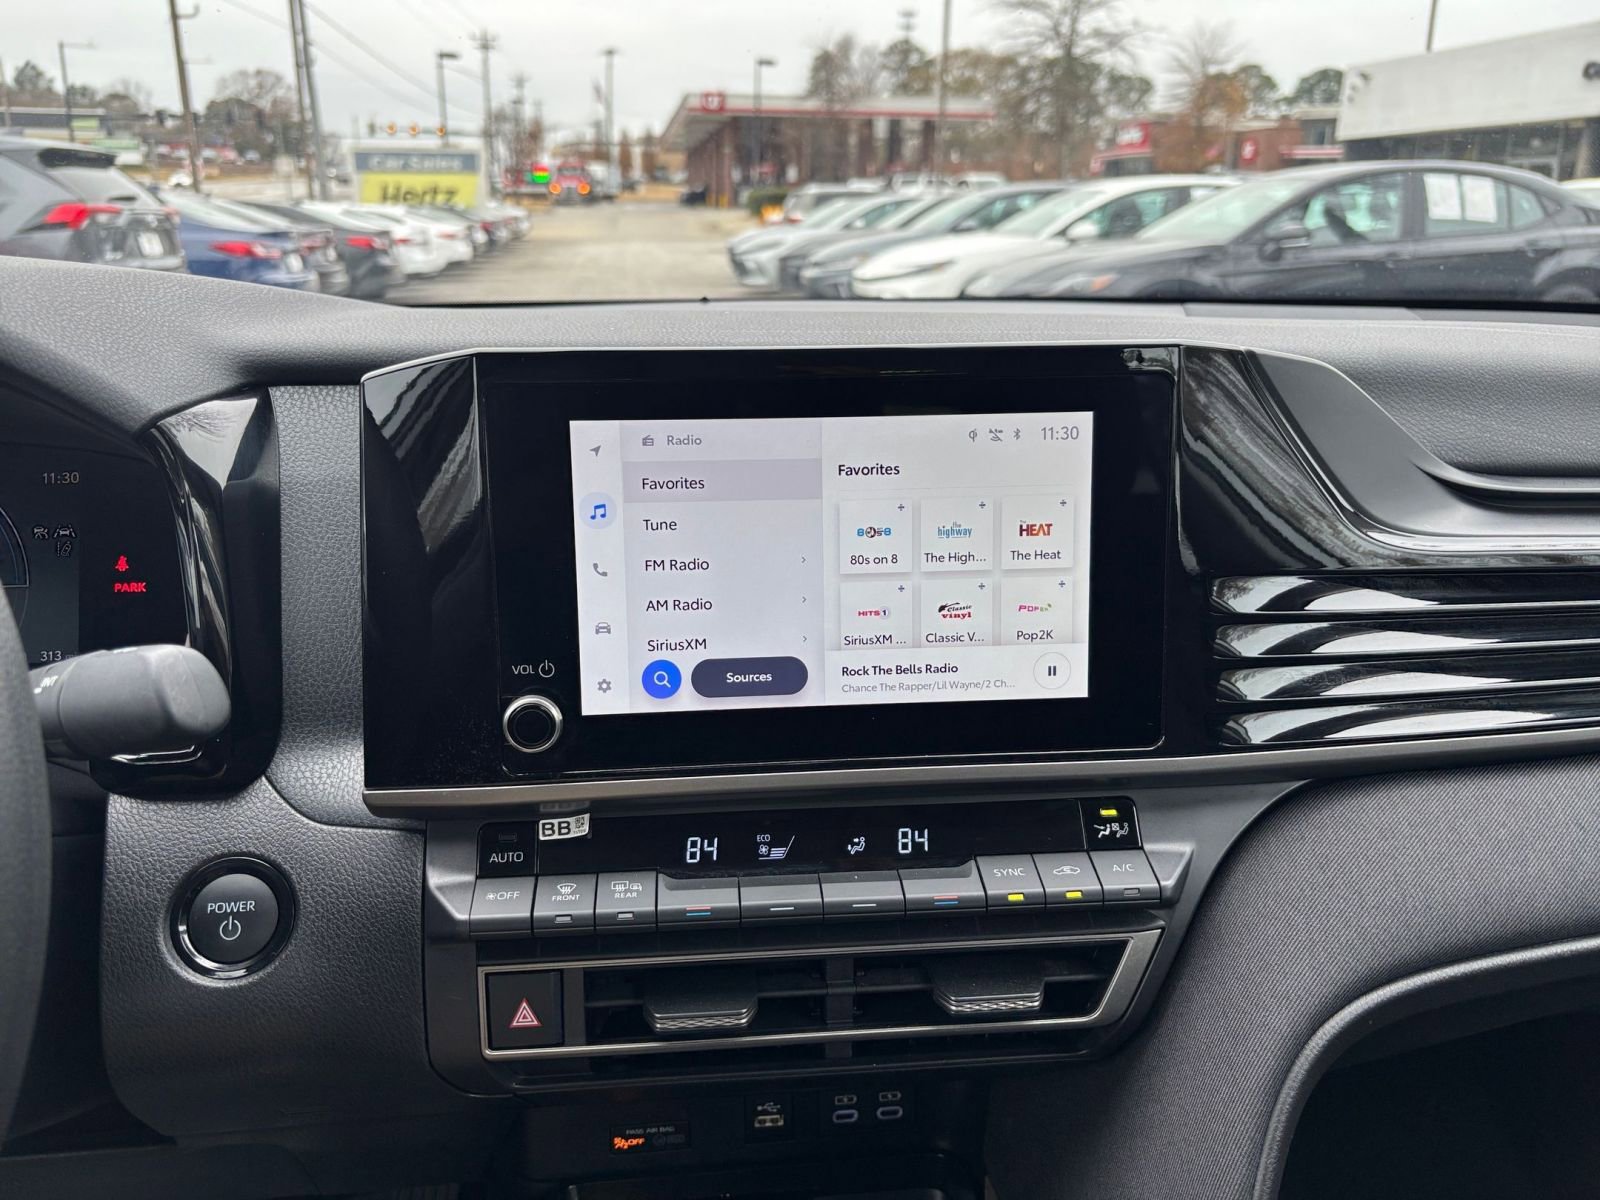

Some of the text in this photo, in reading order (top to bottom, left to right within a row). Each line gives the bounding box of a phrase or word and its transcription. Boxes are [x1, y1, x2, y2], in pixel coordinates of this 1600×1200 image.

[381, 182, 459, 205] Hertz
[1040, 425, 1080, 441] 11:30
[666, 434, 703, 446] Radio
[838, 463, 900, 477] Favorites
[42, 472, 80, 485] 11:30
[641, 476, 705, 490] Favorites
[643, 518, 678, 531] Tune
[1019, 523, 1053, 537] HEAT
[937, 525, 973, 539] highway
[850, 554, 898, 565] 80s on 8
[924, 552, 946, 563] The
[1010, 549, 1061, 560] The Heat
[645, 558, 709, 572] FM Radio
[114, 582, 147, 592] PARK
[645, 598, 713, 612] AM Radio
[947, 603, 972, 613] Classic
[858, 608, 880, 617] HITS
[941, 611, 972, 620] vinyl
[843, 634, 893, 646] SiriusXM
[925, 632, 965, 643] Classic
[1016, 630, 1054, 642] Pop2K
[647, 638, 707, 652] SiriusXM
[40, 651, 62, 662] 313
[511, 664, 535, 675] VOL
[841, 663, 959, 677] Rock The Bells Radio
[726, 672, 773, 683] Sources
[841, 683, 877, 693] Chance
[880, 683, 896, 692] The
[898, 680, 948, 694] Rapper/Lil
[949, 680, 991, 692] Wayne/2
[541, 821, 571, 837] BB
[757, 834, 770, 842] ECO
[898, 827, 929, 854] 84
[686, 836, 718, 863] 84
[489, 851, 524, 863] AUTO
[993, 867, 1026, 878] SYNC
[1112, 863, 1135, 873] A/C
[496, 890, 521, 901] OFF
[551, 893, 581, 902] FRONT
[614, 890, 638, 899] REAR
[207, 900, 256, 914] POWER
[627, 1138, 645, 1146] OFF
